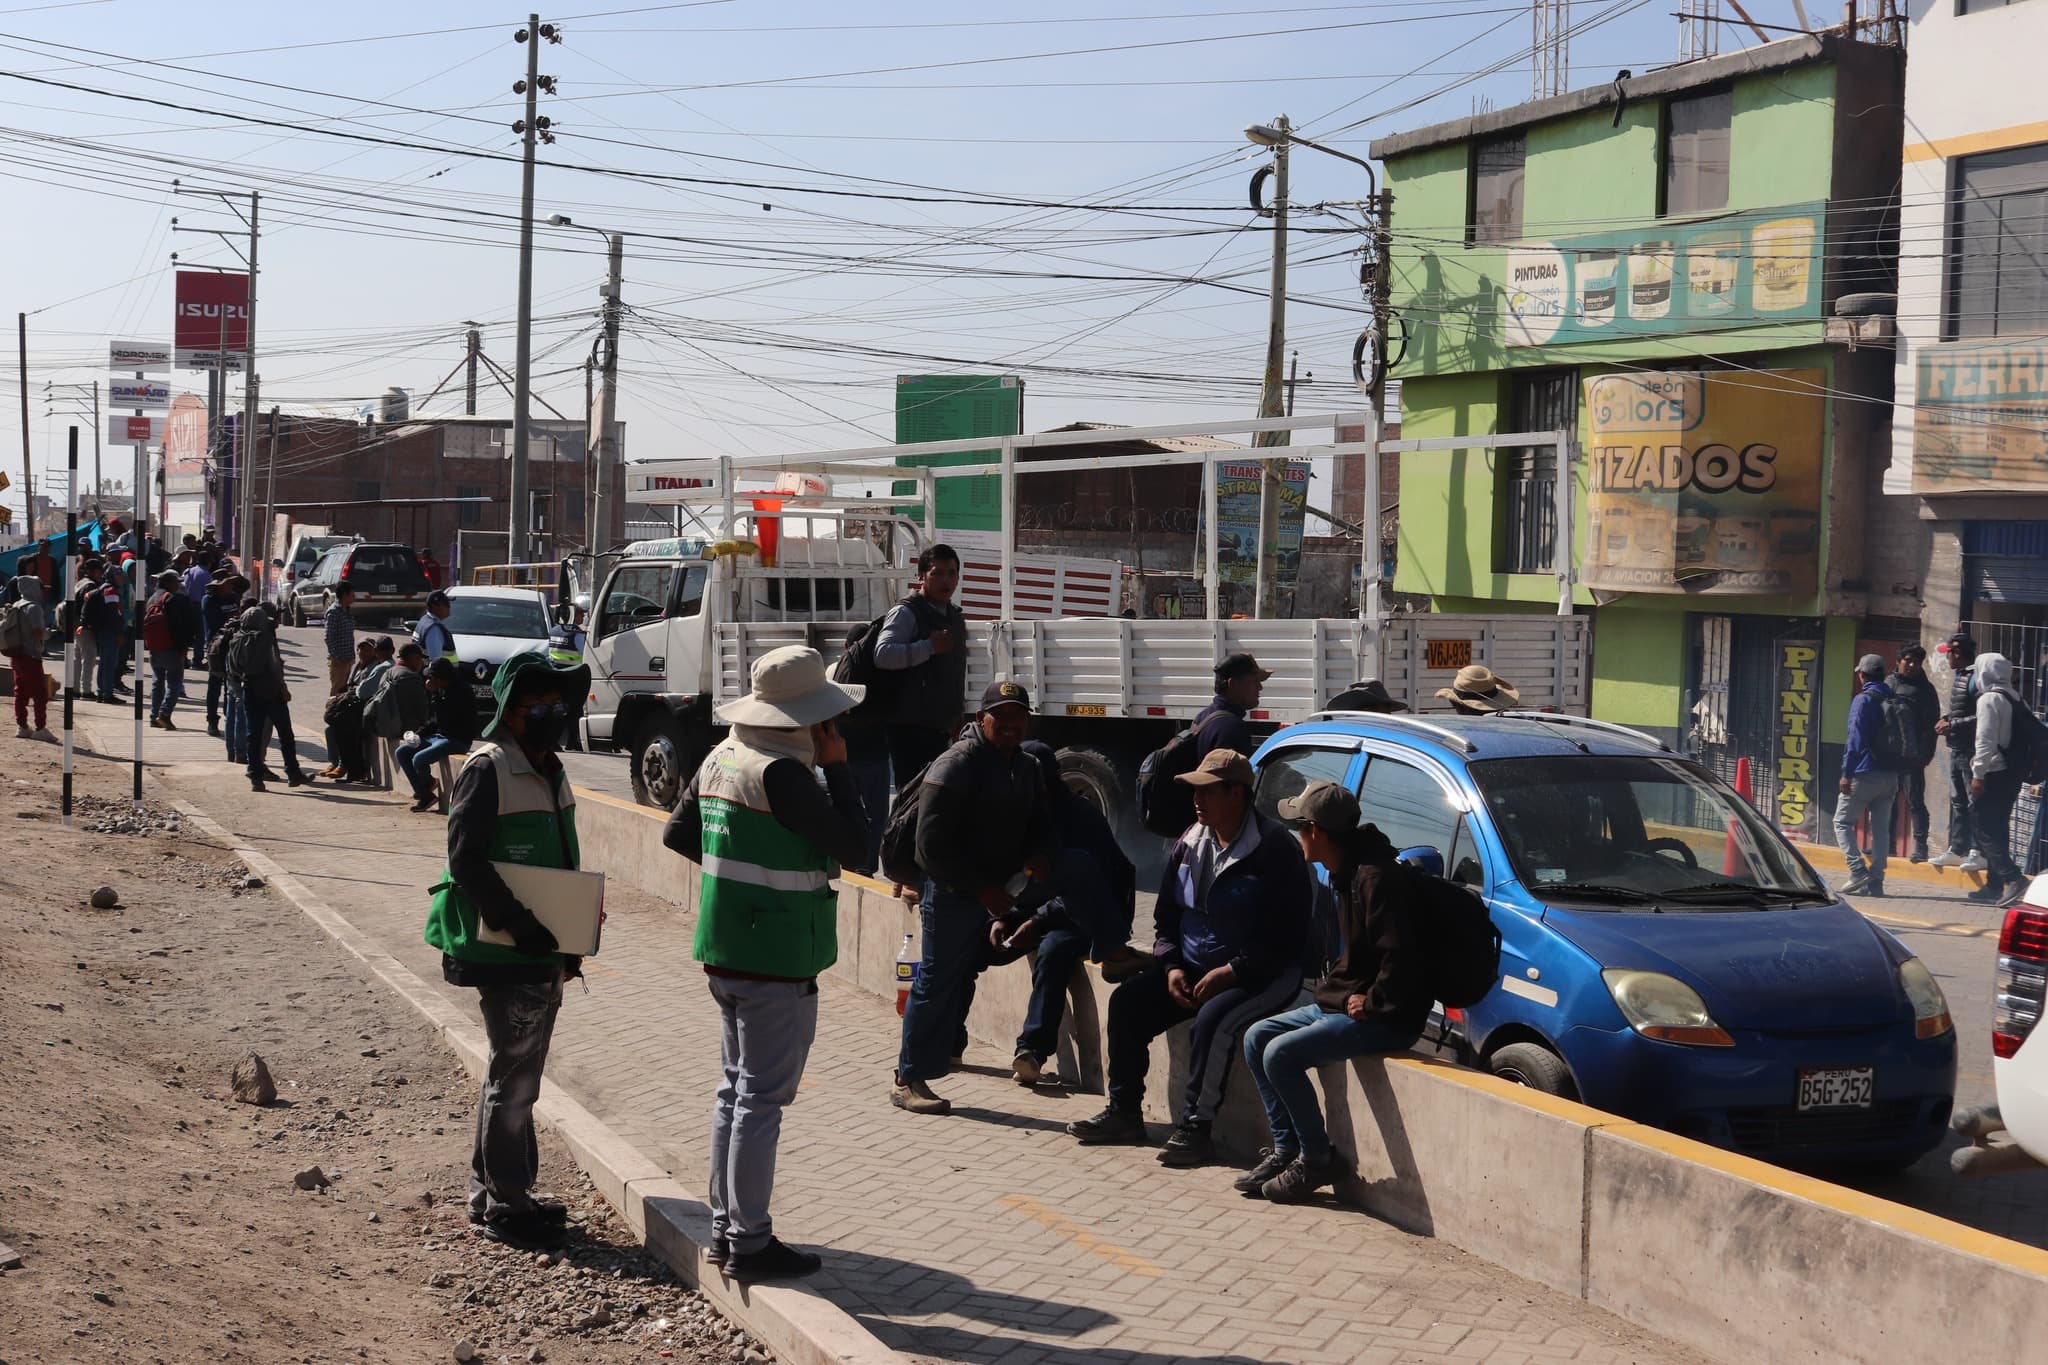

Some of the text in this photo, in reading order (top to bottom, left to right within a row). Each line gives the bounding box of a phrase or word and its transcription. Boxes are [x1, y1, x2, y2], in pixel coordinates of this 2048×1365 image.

[216, 361, 240, 369] CARA
[111, 384, 168, 397] SUNWARD
[1223, 464, 1305, 481] TRANSTES
[655, 477, 702, 489] ITALIA
[1776, 647, 1816, 825] PINTURAS
[1801, 1077, 1871, 1106] B5G-252
